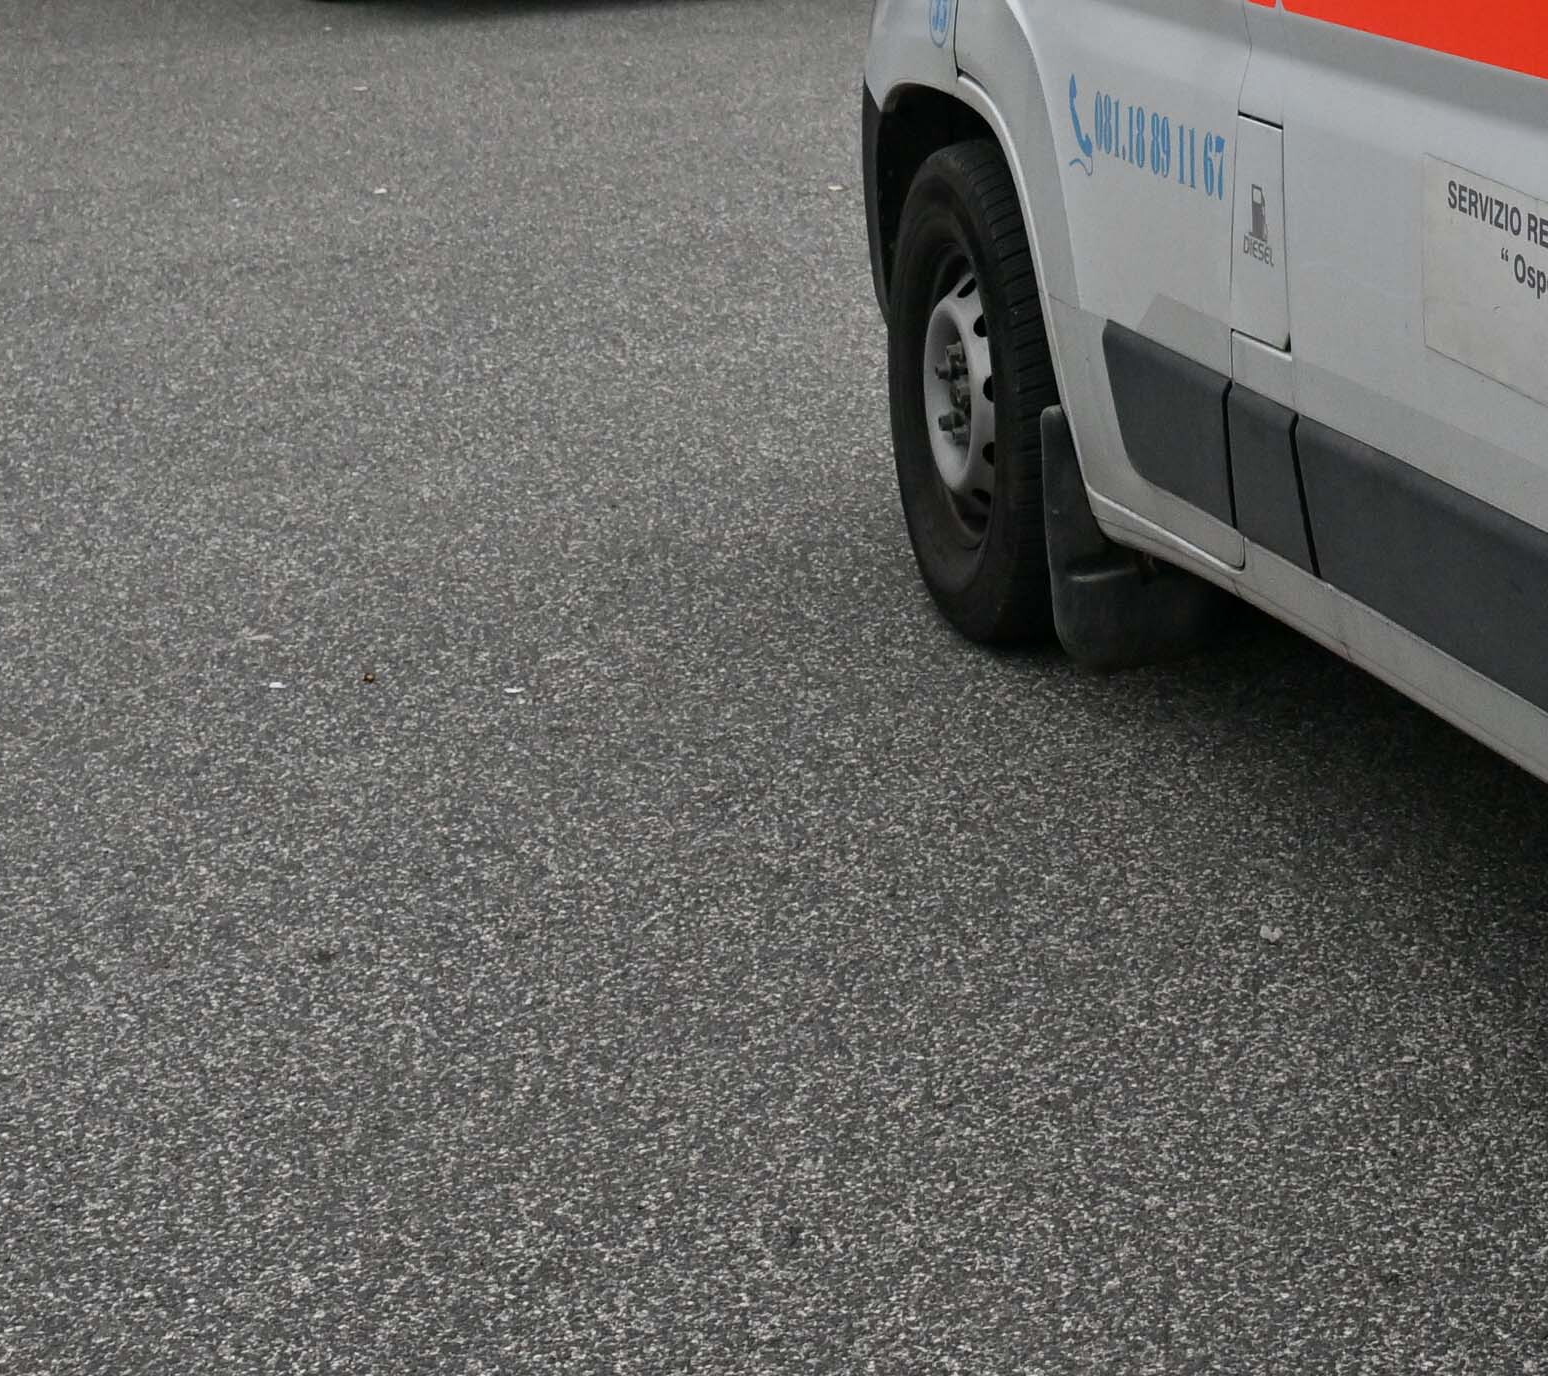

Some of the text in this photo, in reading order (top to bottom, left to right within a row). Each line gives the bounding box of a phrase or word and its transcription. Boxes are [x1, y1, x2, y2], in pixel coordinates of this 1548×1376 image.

[1094, 90, 1226, 201] 081.18 89 11 67
[1447, 180, 1522, 237] SERVIZIO
[1243, 233, 1275, 268] DIESEL
